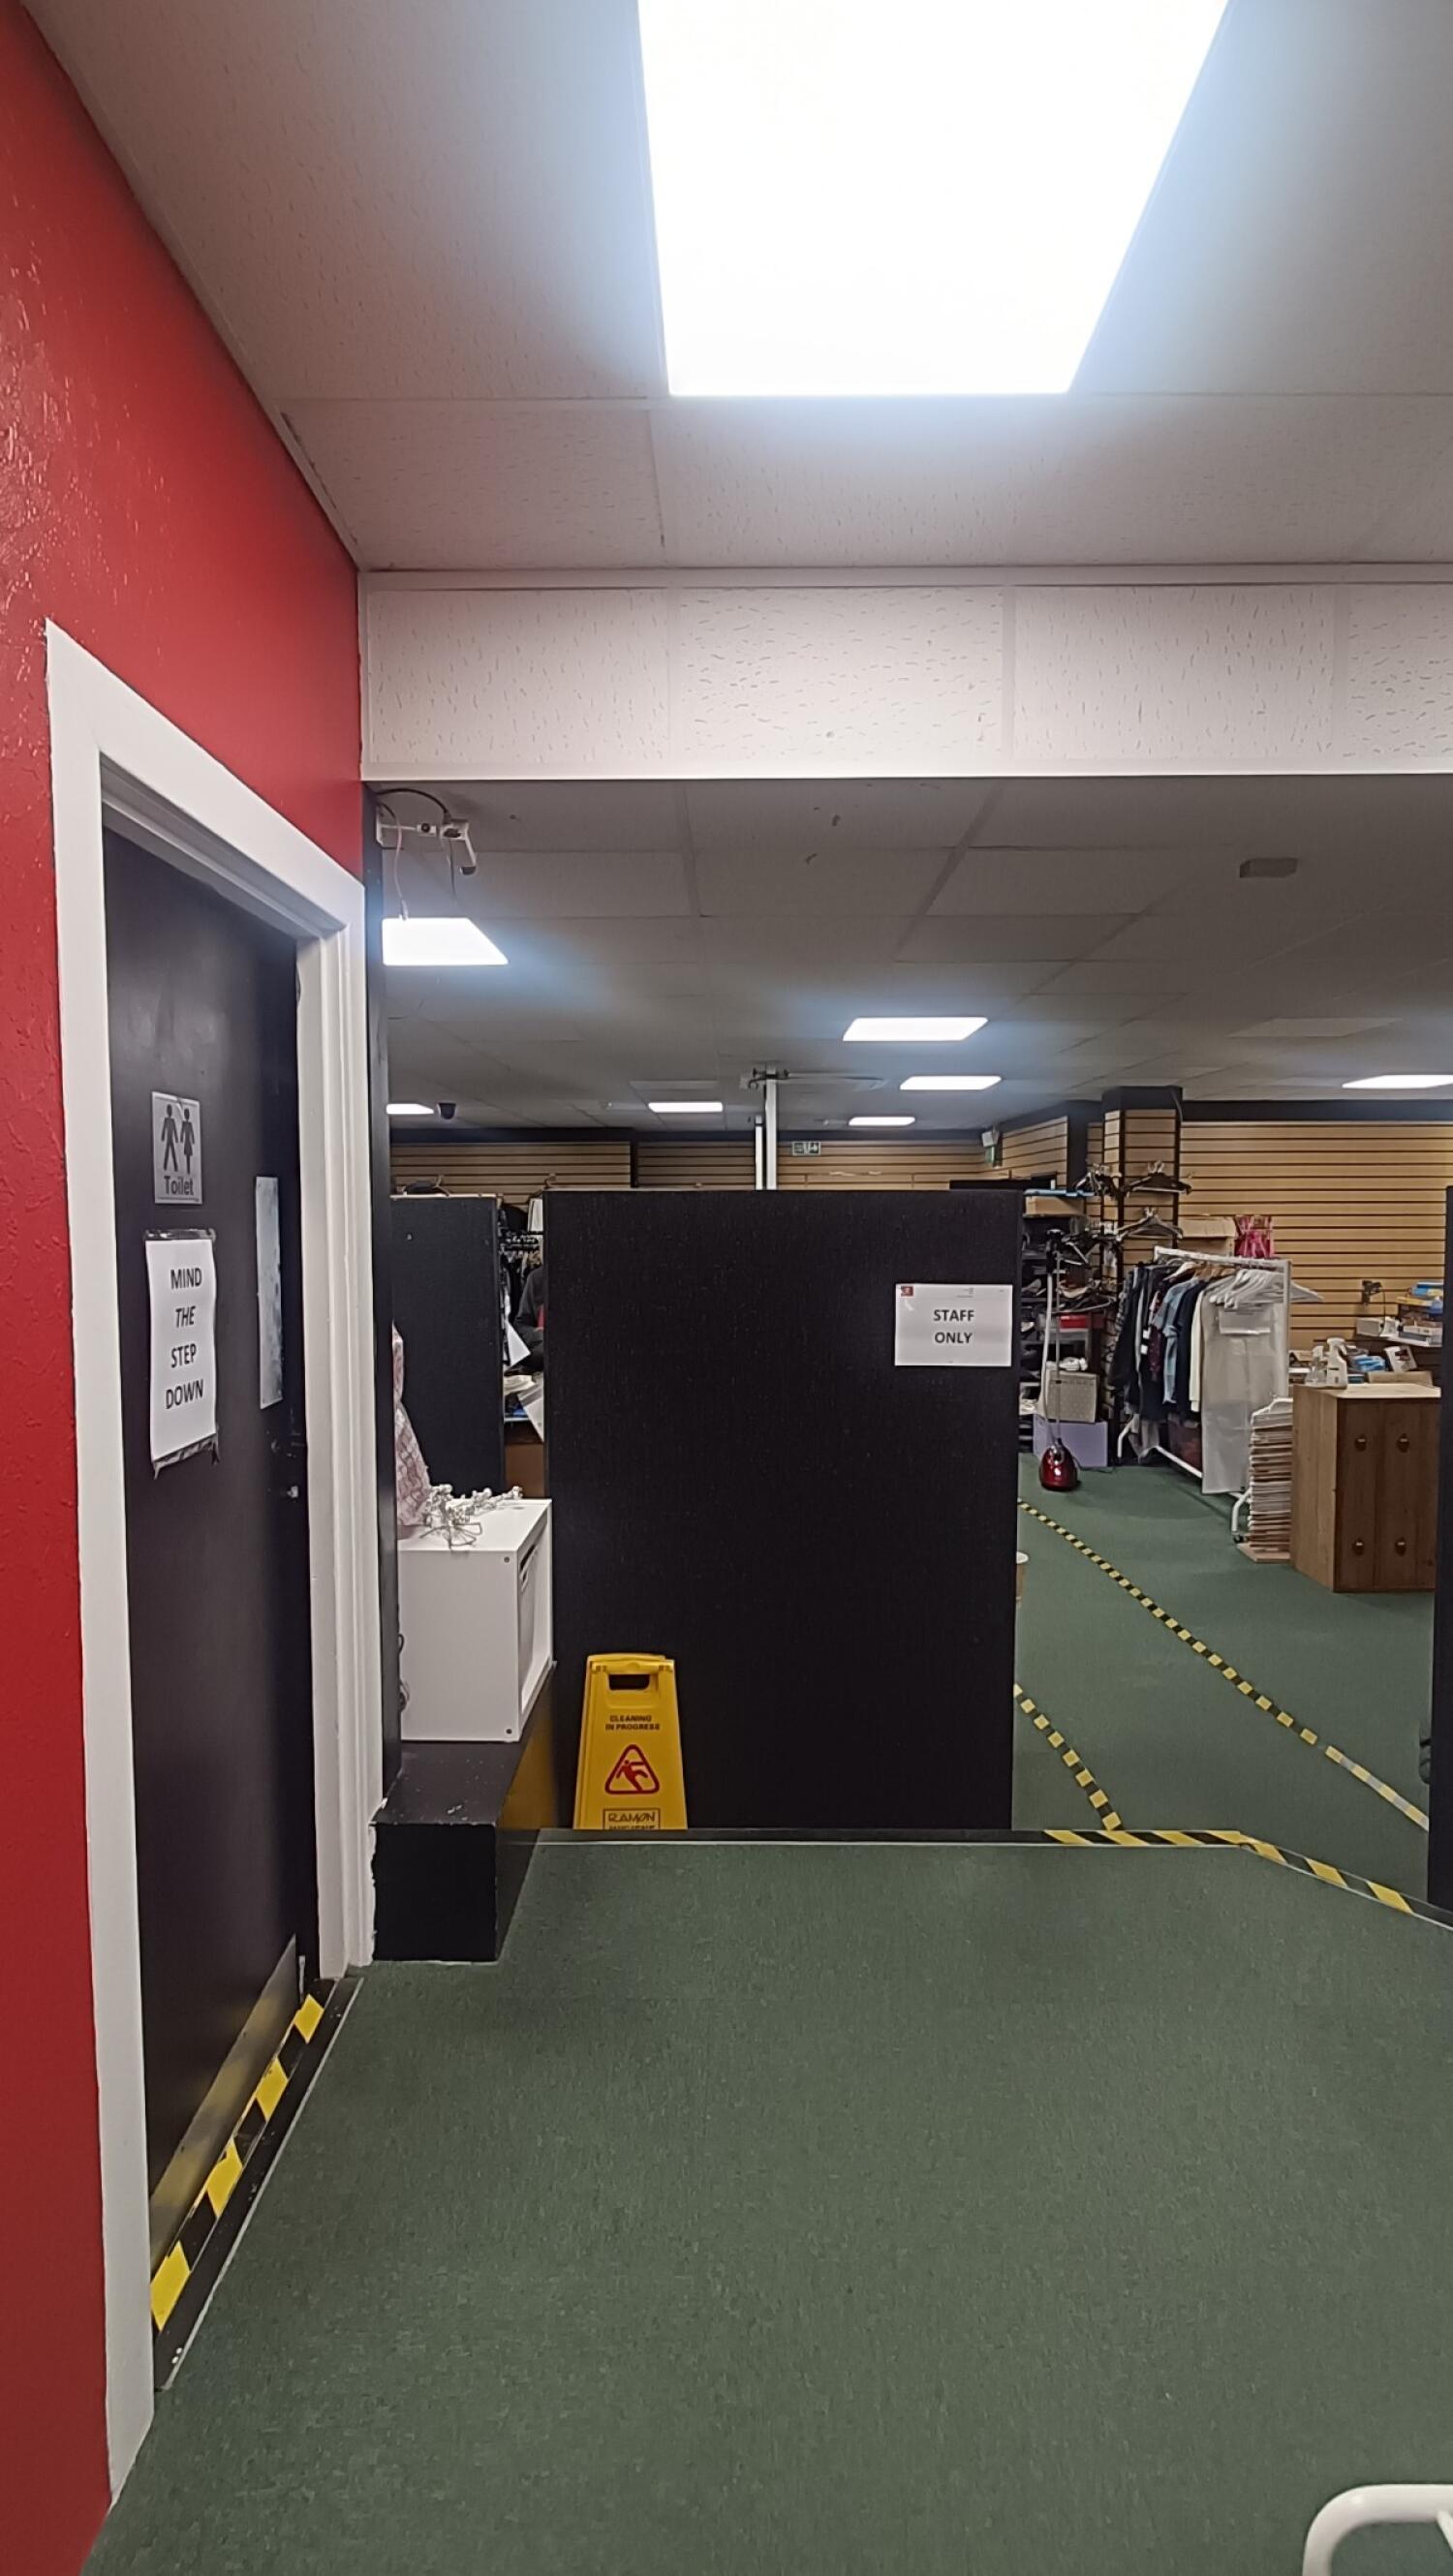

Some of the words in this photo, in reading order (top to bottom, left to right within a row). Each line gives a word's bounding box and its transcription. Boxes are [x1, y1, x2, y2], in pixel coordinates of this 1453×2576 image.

[164, 1176, 194, 1196] Toilet
[170, 1268, 202, 1290] MIND
[175, 1305, 197, 1329] THE
[933, 1309, 974, 1322] STAFF
[934, 1332, 973, 1344] ONLY
[170, 1343, 198, 1368] STEP
[166, 1379, 204, 1410] DOWN
